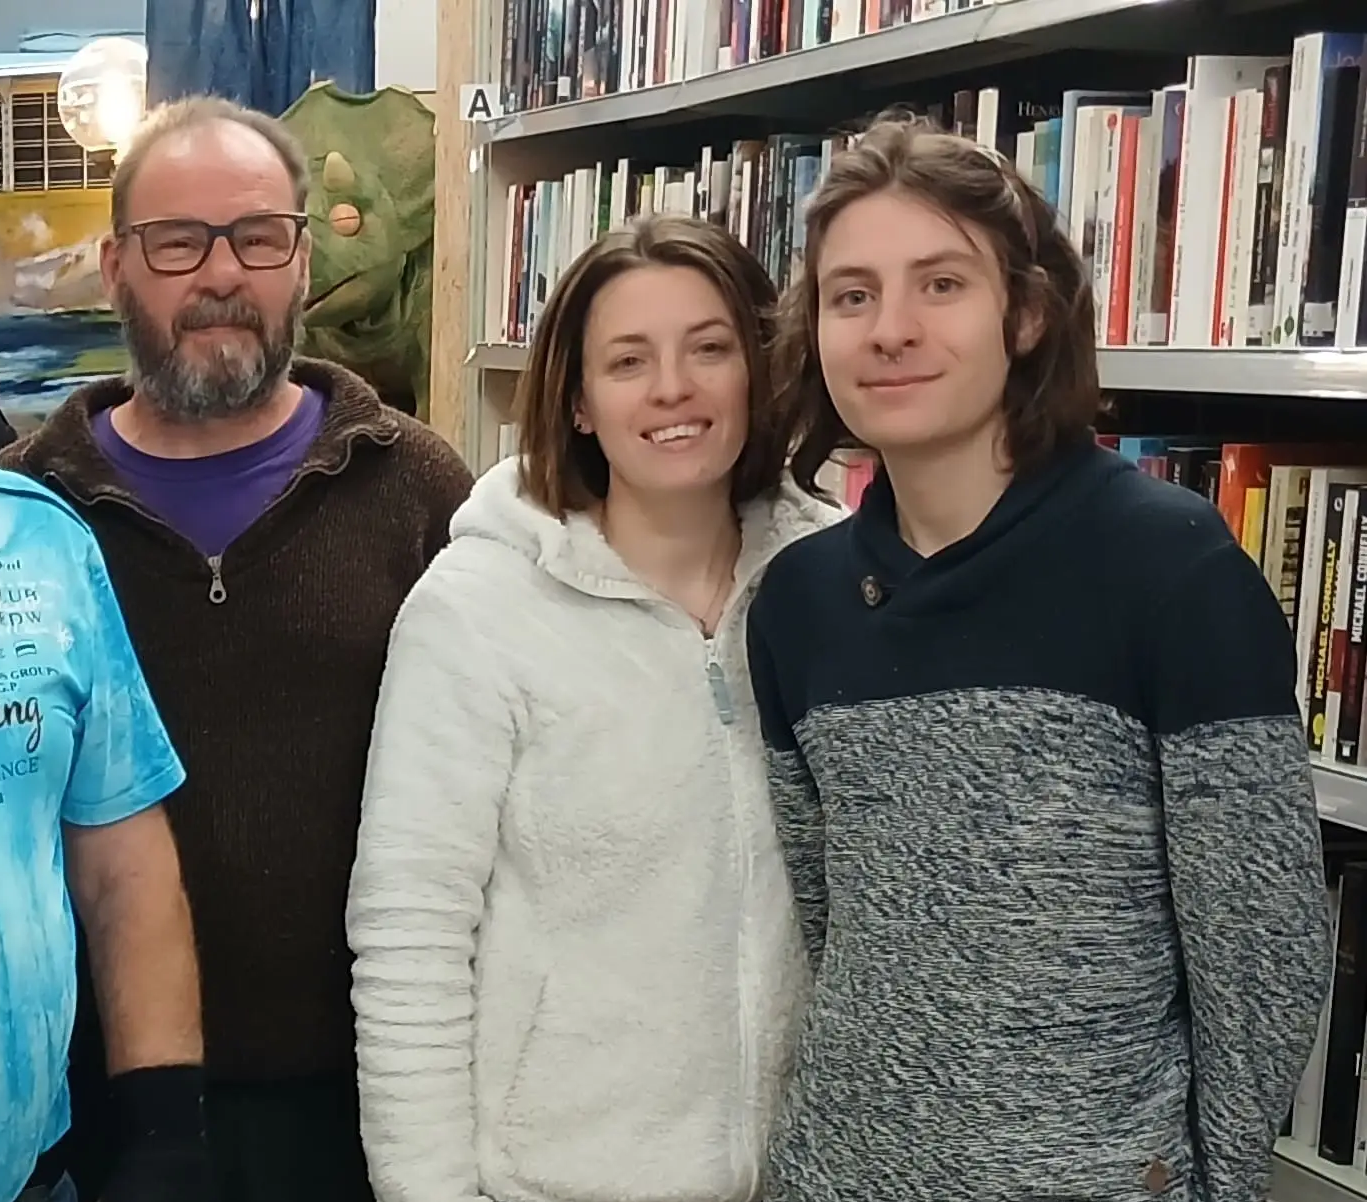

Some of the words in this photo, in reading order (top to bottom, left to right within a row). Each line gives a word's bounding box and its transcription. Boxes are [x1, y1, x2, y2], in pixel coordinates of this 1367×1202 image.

[468, 89, 491, 118] A
[1315, 627, 1329, 698] MICHAEL
[1322, 537, 1337, 624] CONNELLY
